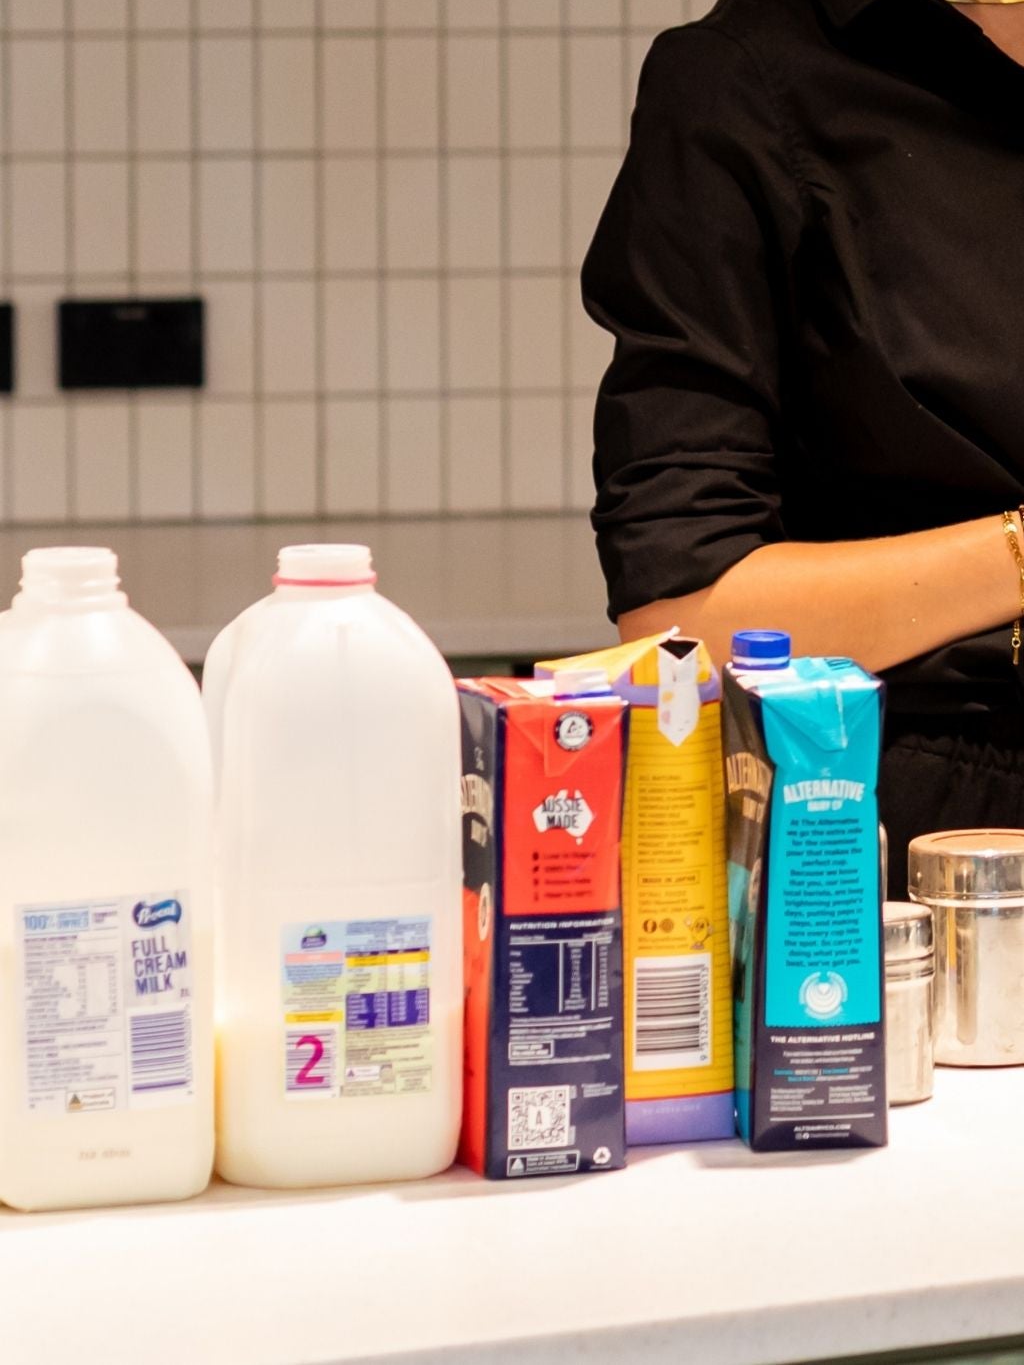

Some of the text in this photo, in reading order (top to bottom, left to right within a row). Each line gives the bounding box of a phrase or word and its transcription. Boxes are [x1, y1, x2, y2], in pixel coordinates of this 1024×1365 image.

[784, 779, 865, 804] ALTERNATIVE
[542, 797, 583, 814] AUSSIE
[546, 813, 579, 829] MADE
[510, 917, 614, 930] NUTRITION INFORMATION
[131, 936, 169, 958] FULL
[133, 951, 188, 977] CREAM
[135, 973, 173, 996] MILK
[770, 1035, 786, 1043] THE
[787, 1034, 841, 1043] ALTERNATIVE
[295, 1035, 325, 1084] 2
